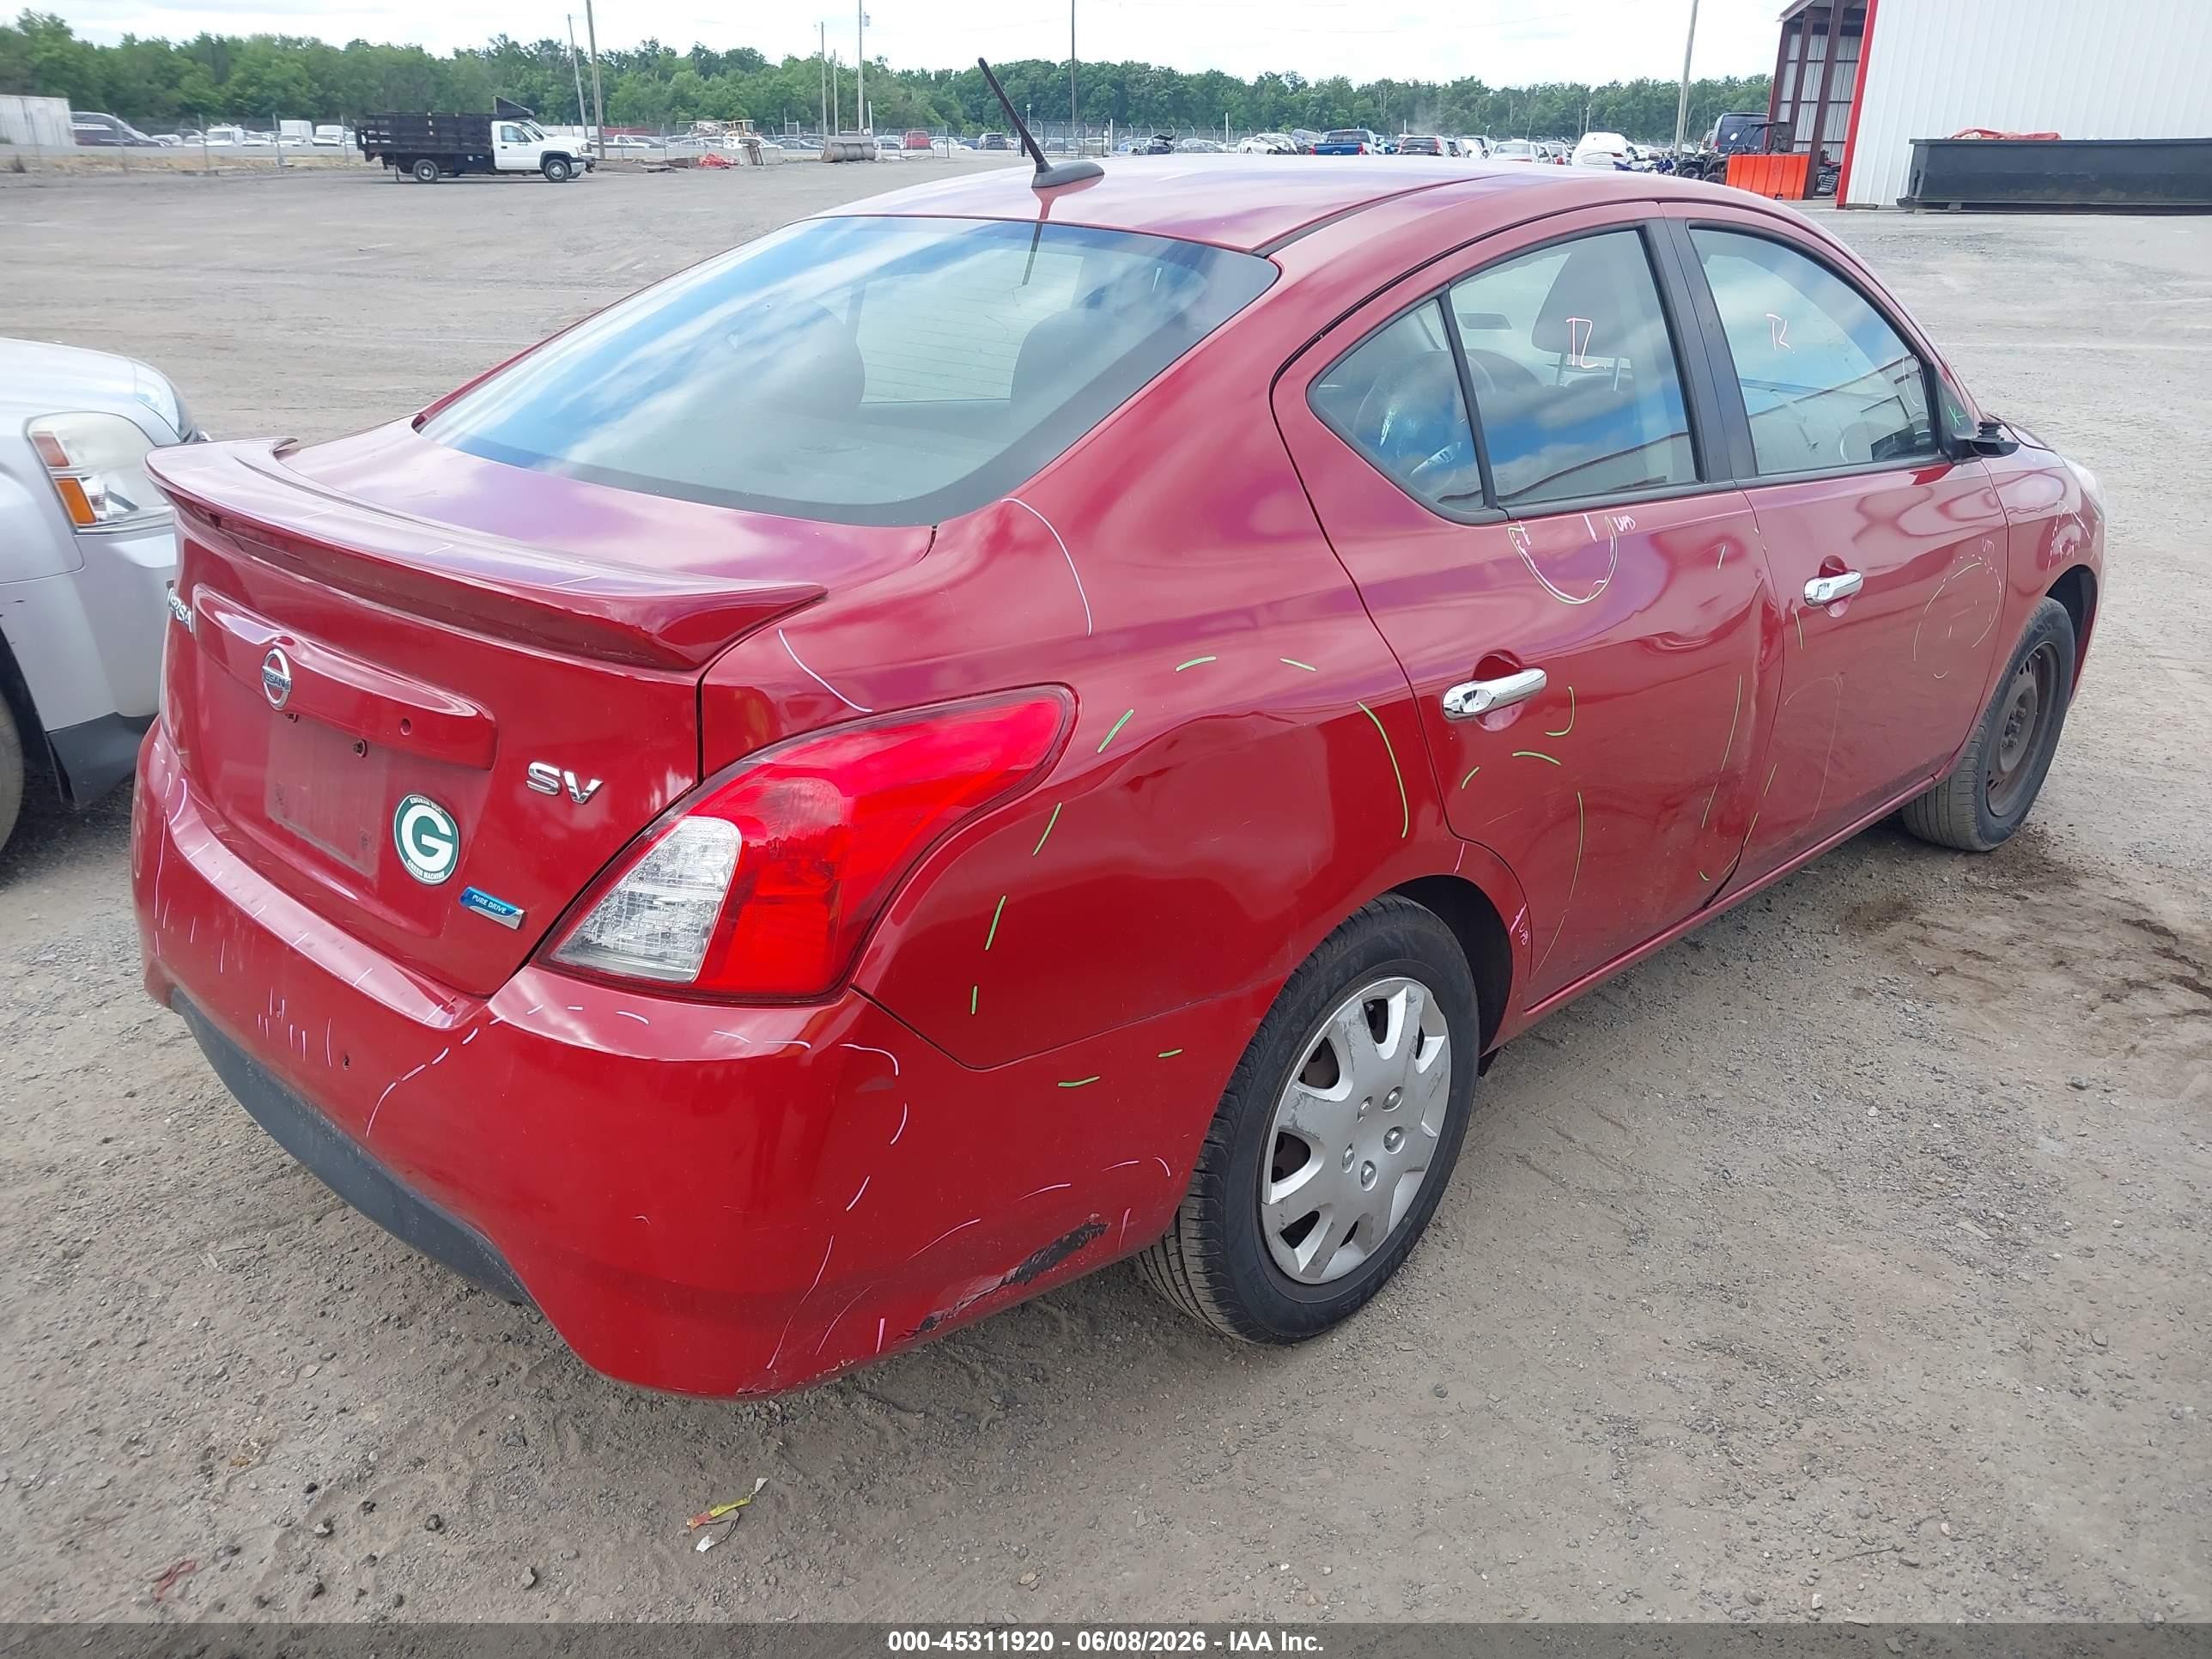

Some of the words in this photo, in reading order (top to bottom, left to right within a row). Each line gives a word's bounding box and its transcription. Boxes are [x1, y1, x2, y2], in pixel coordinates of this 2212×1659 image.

[526, 761, 605, 805] SV
[401, 803, 453, 873] G
[471, 894, 489, 906] PURE
[488, 901, 507, 915] DRIVE
